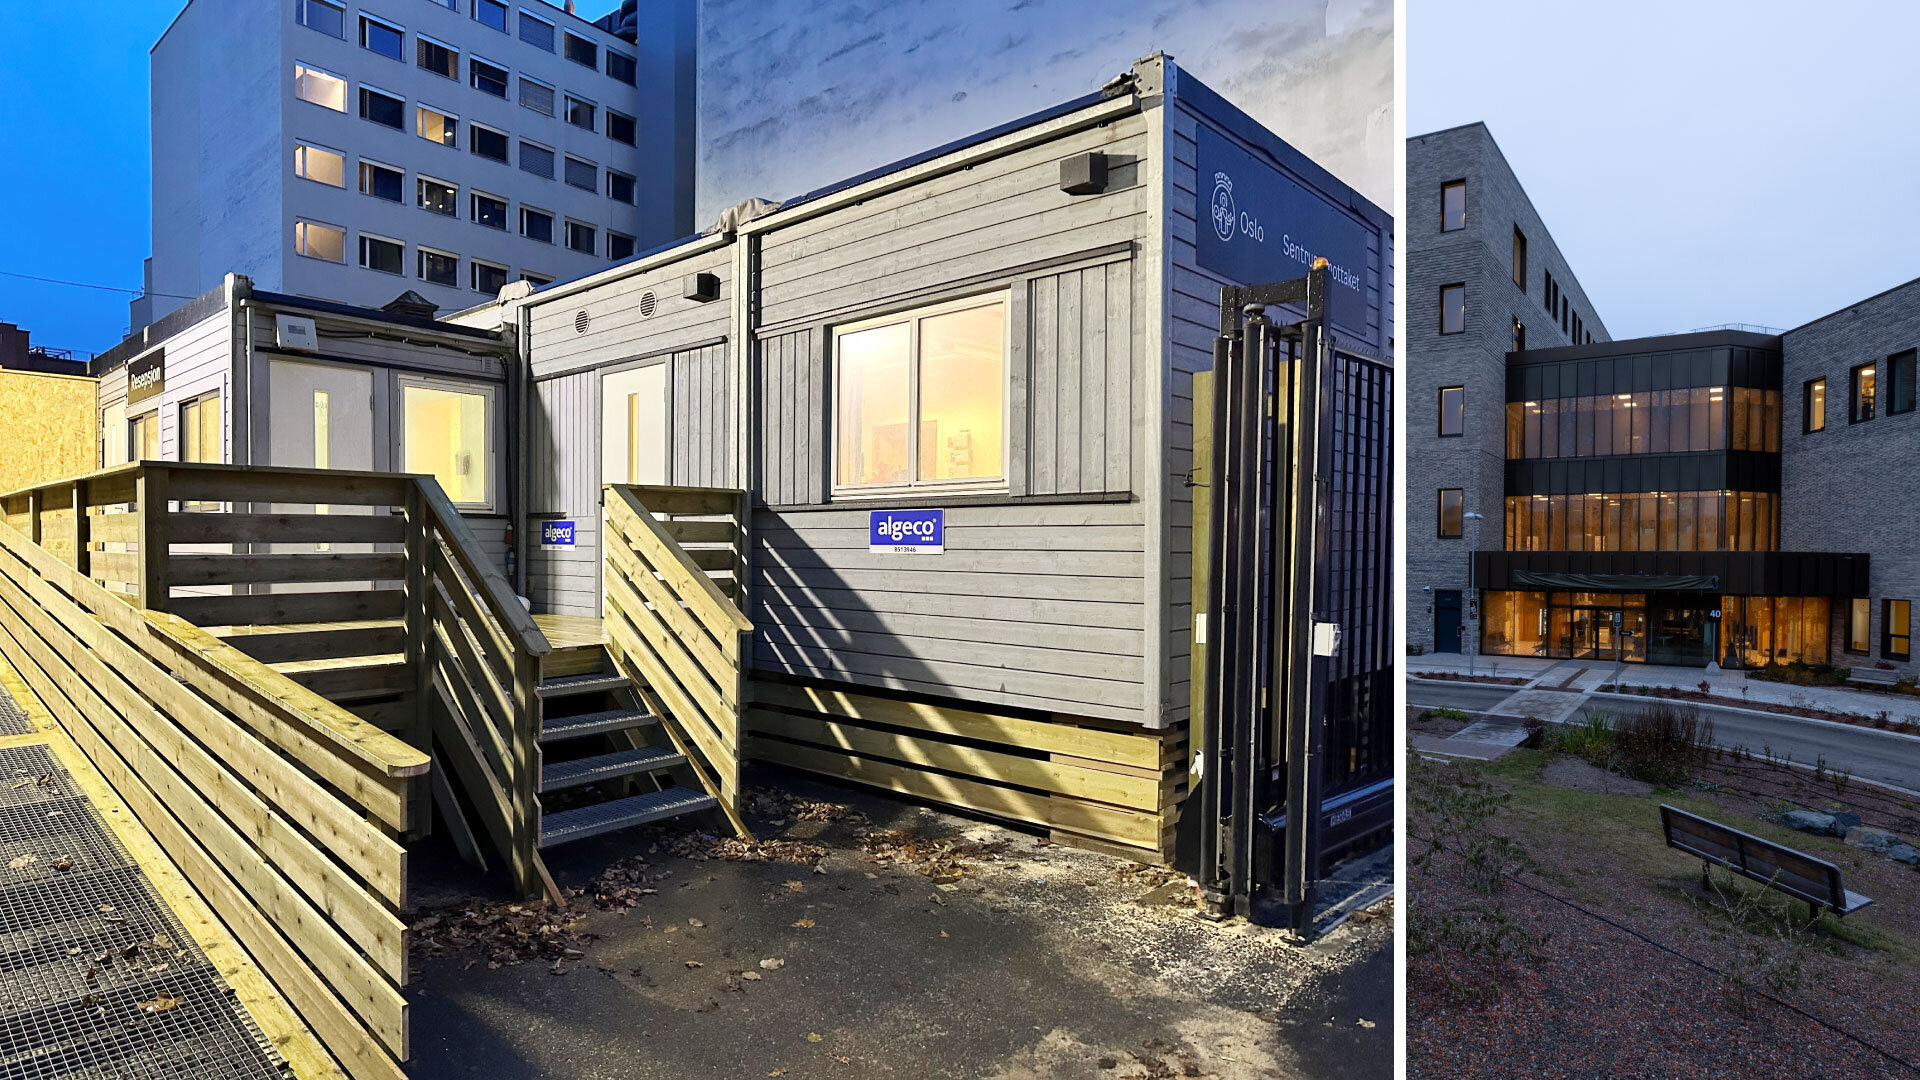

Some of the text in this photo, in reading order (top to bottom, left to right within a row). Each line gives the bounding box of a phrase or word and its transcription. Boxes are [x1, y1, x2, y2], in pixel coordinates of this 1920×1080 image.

[1240, 211, 1360, 292] Oslo Sentrumottaket
[131, 365, 161, 391] Resepsjon
[1709, 609, 1721, 618] 40
